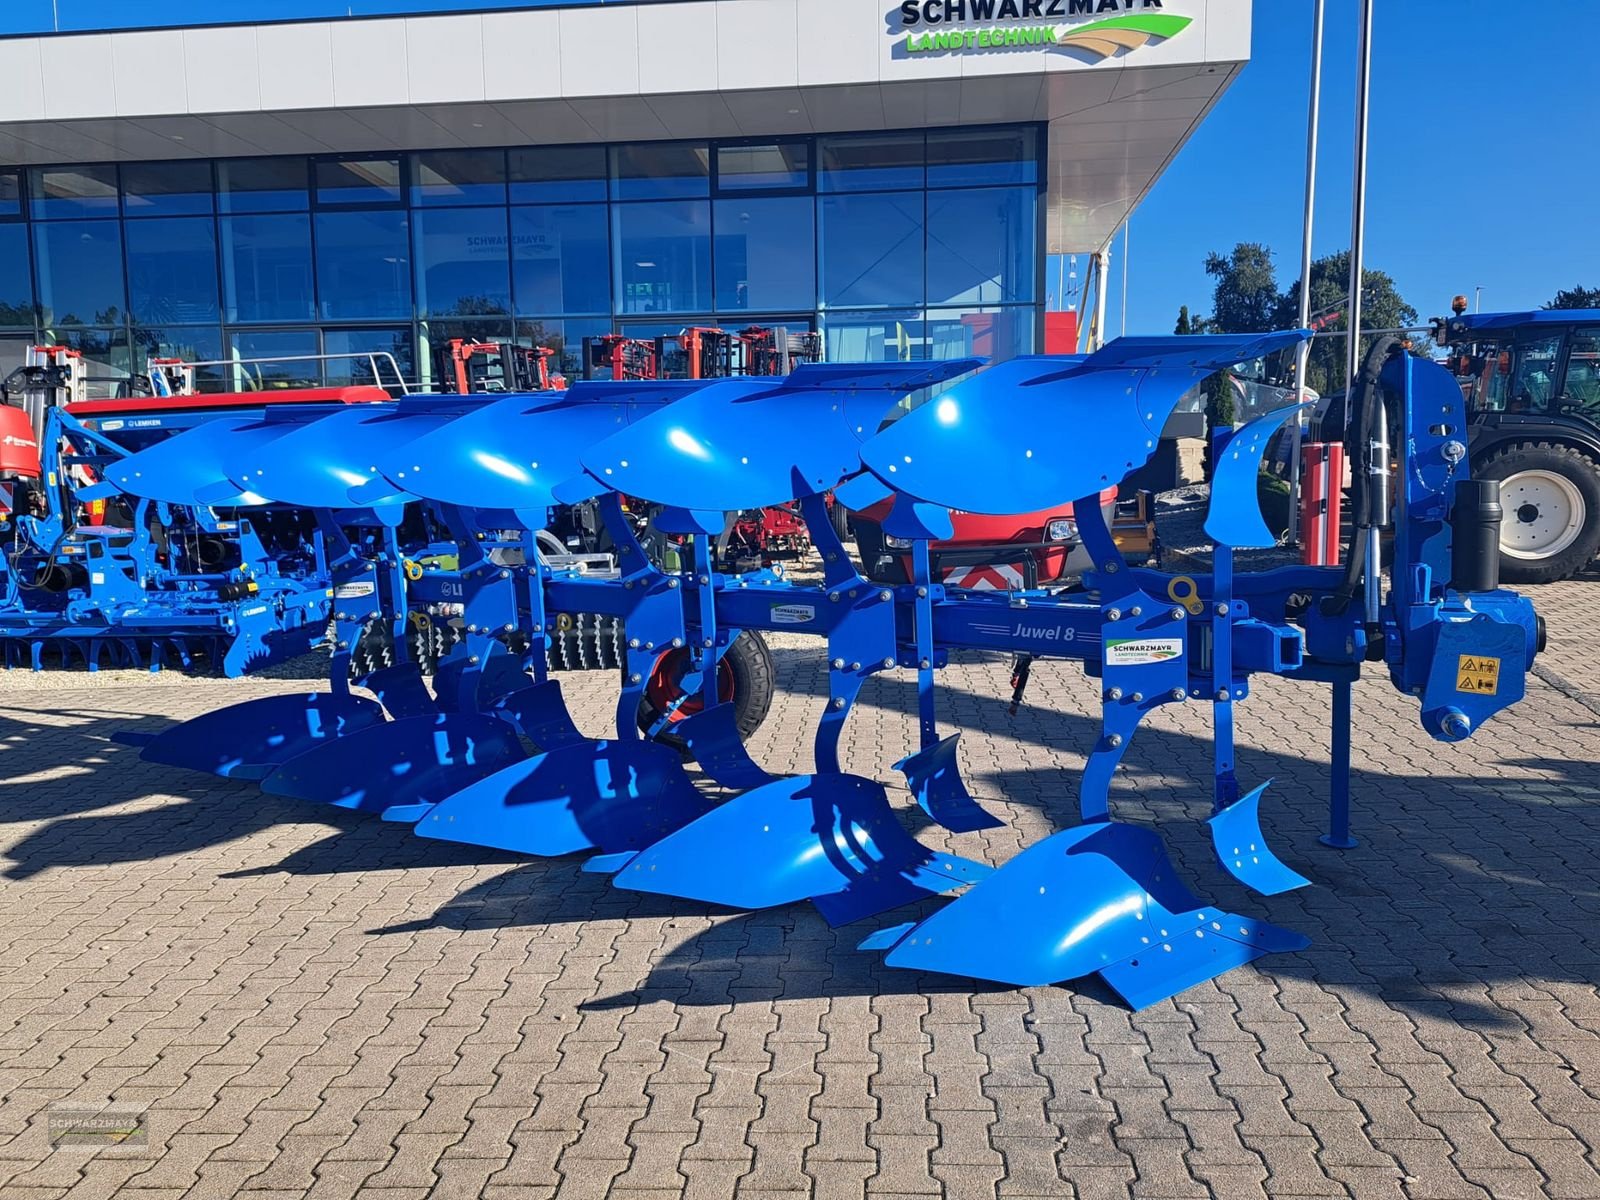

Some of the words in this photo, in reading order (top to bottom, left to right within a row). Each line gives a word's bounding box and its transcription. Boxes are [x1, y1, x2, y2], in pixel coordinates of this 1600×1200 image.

[907, 26, 1058, 51] LANDTECHNIK
[467, 234, 546, 246] SCHWAZMAYR
[134, 419, 162, 427] LEMKEN
[1012, 623, 1061, 641] Juwel
[1064, 627, 1075, 641] 8
